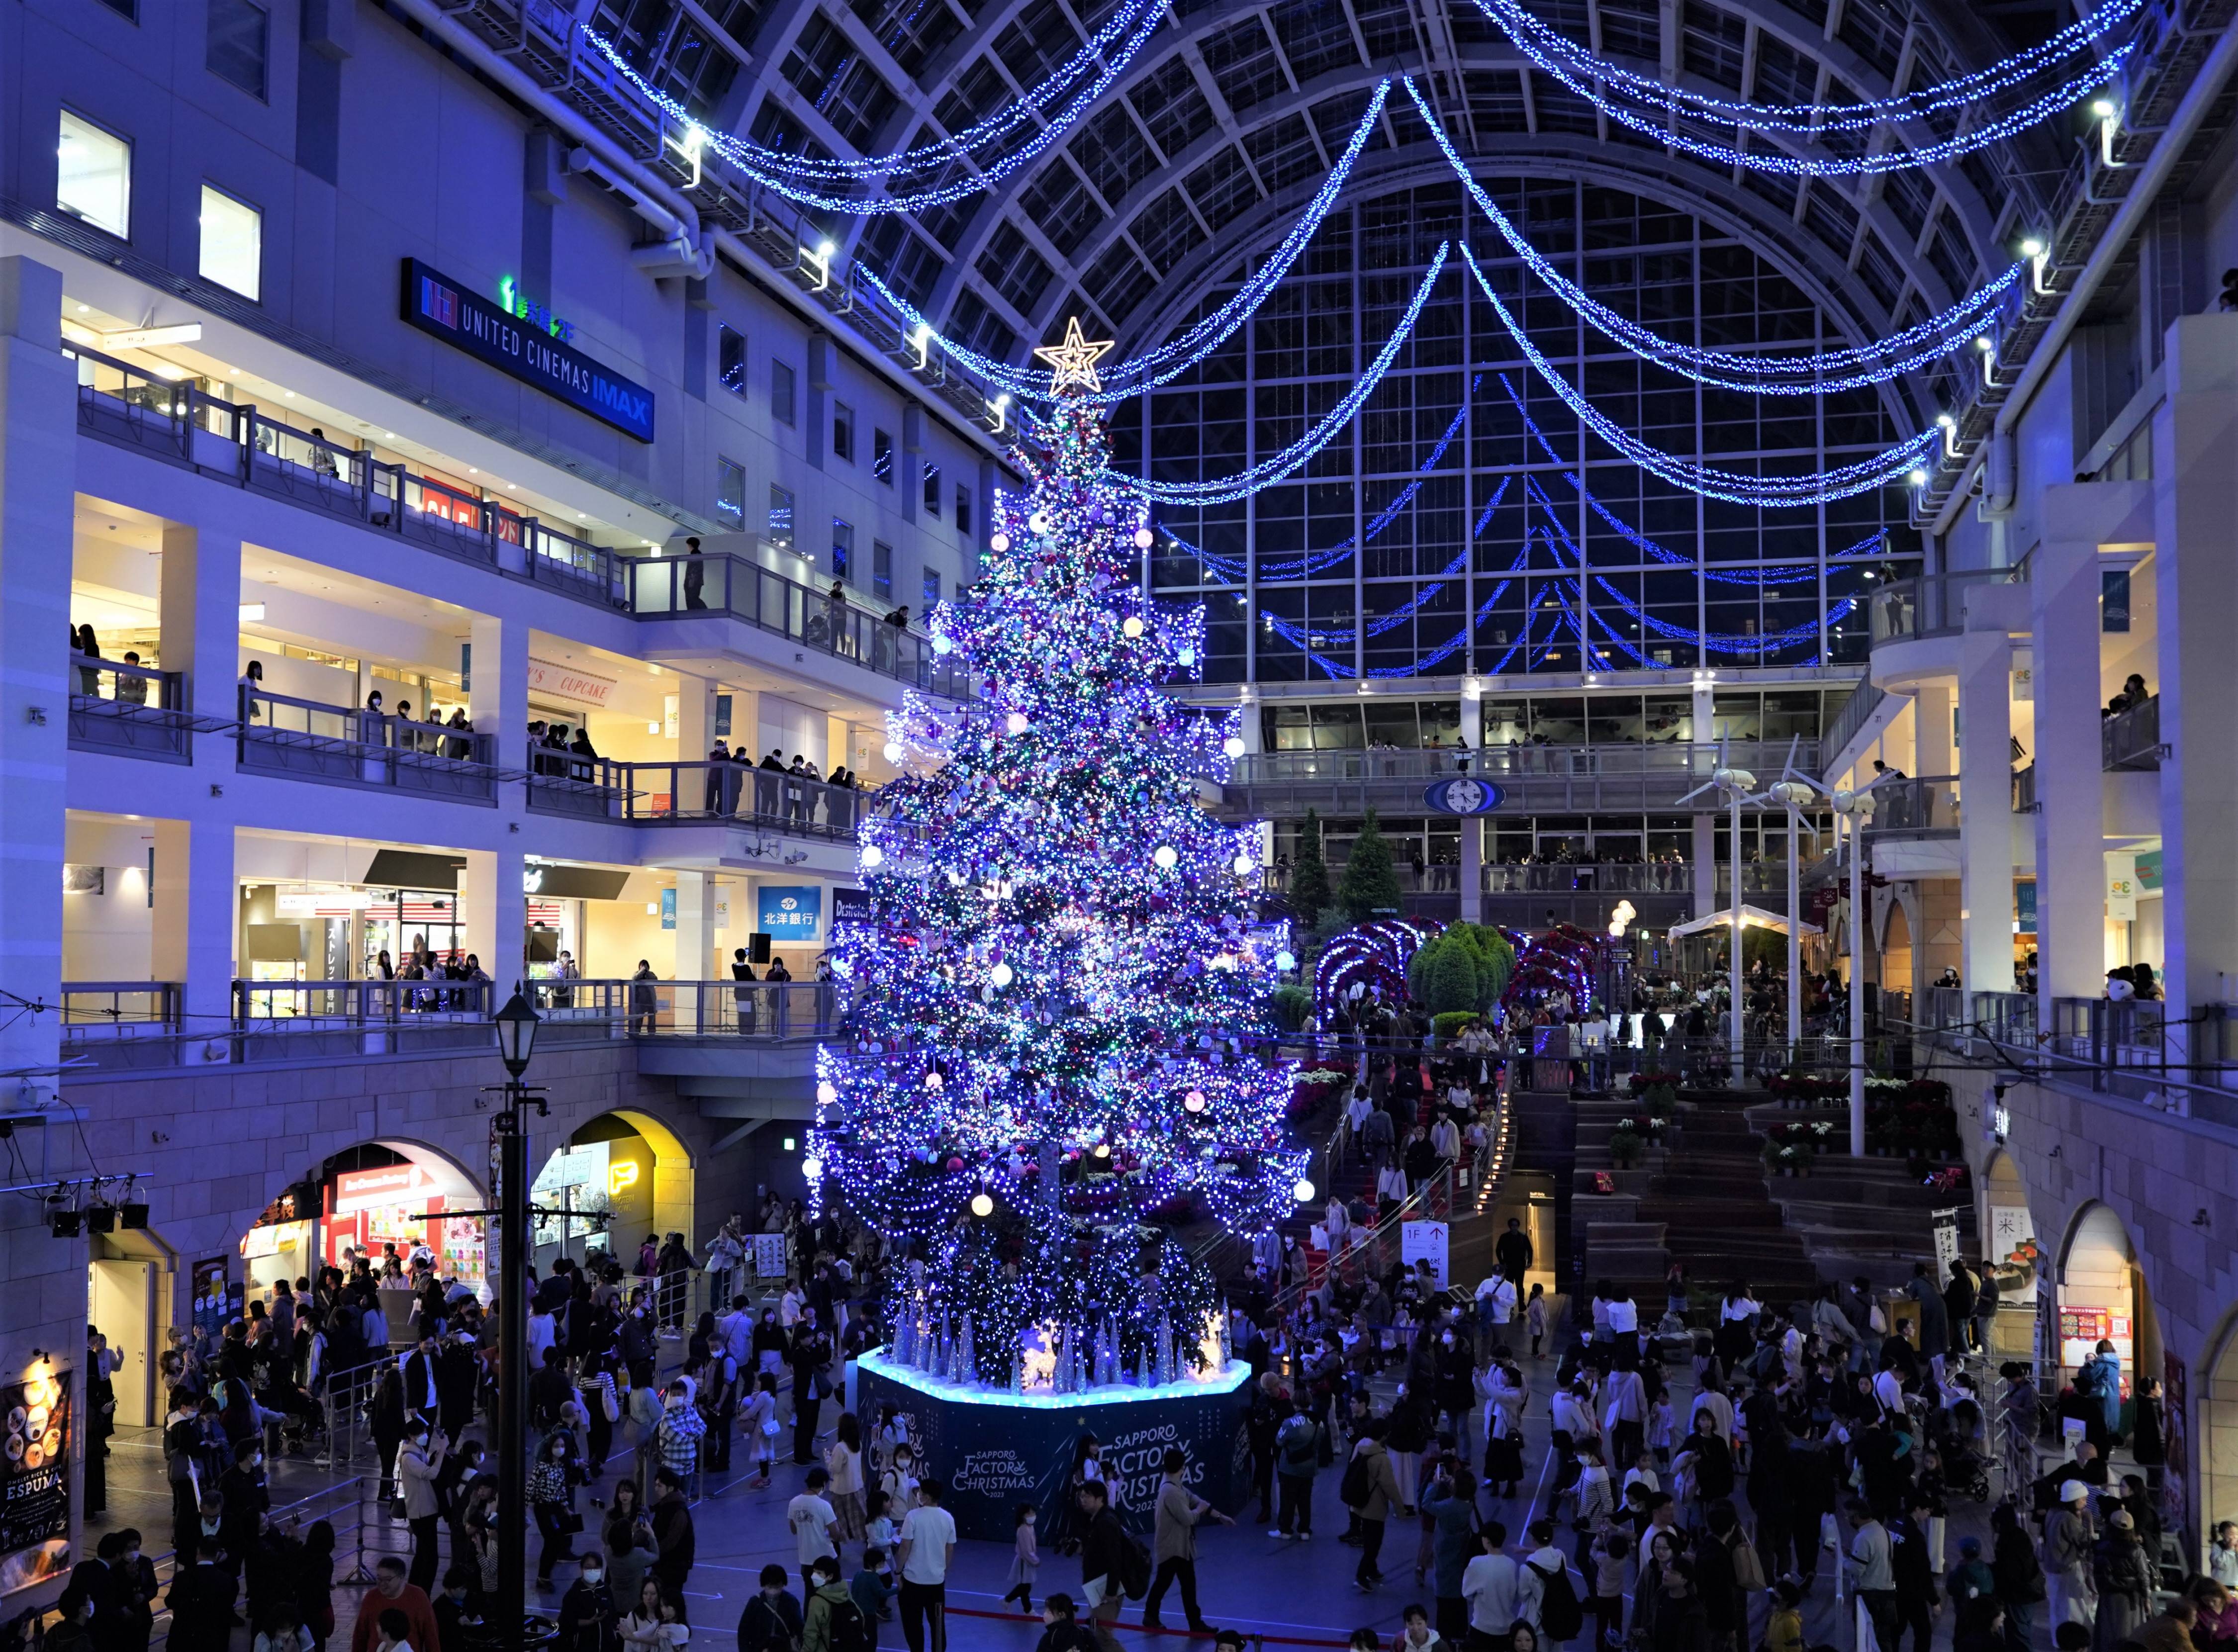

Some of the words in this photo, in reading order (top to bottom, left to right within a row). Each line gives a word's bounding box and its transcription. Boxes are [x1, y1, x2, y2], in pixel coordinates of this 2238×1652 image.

[463, 304, 519, 356] UNITED
[527, 340, 588, 393] CINEMAS
[593, 374, 647, 426] IMAX
[560, 677, 608, 699] CUPCAKE
[764, 913, 814, 925] 北洋銀行
[612, 1194, 635, 1205] PROTEIN
[1997, 1218, 2015, 1234] 米
[1407, 1229, 1420, 1239] 1F
[445, 1238, 464, 1249] Sweet
[1114, 1424, 1178, 1450] SAPPORO
[976, 1450, 1018, 1461] SAPPORO
[958, 1456, 1027, 1478] FACTORY
[6, 1472, 62, 1500] ESPUMA
[7, 1475, 29, 1486] OMELET
[952, 1473, 1035, 1495] CHRISTMAS
[1135, 1499, 1157, 1513] 2023
